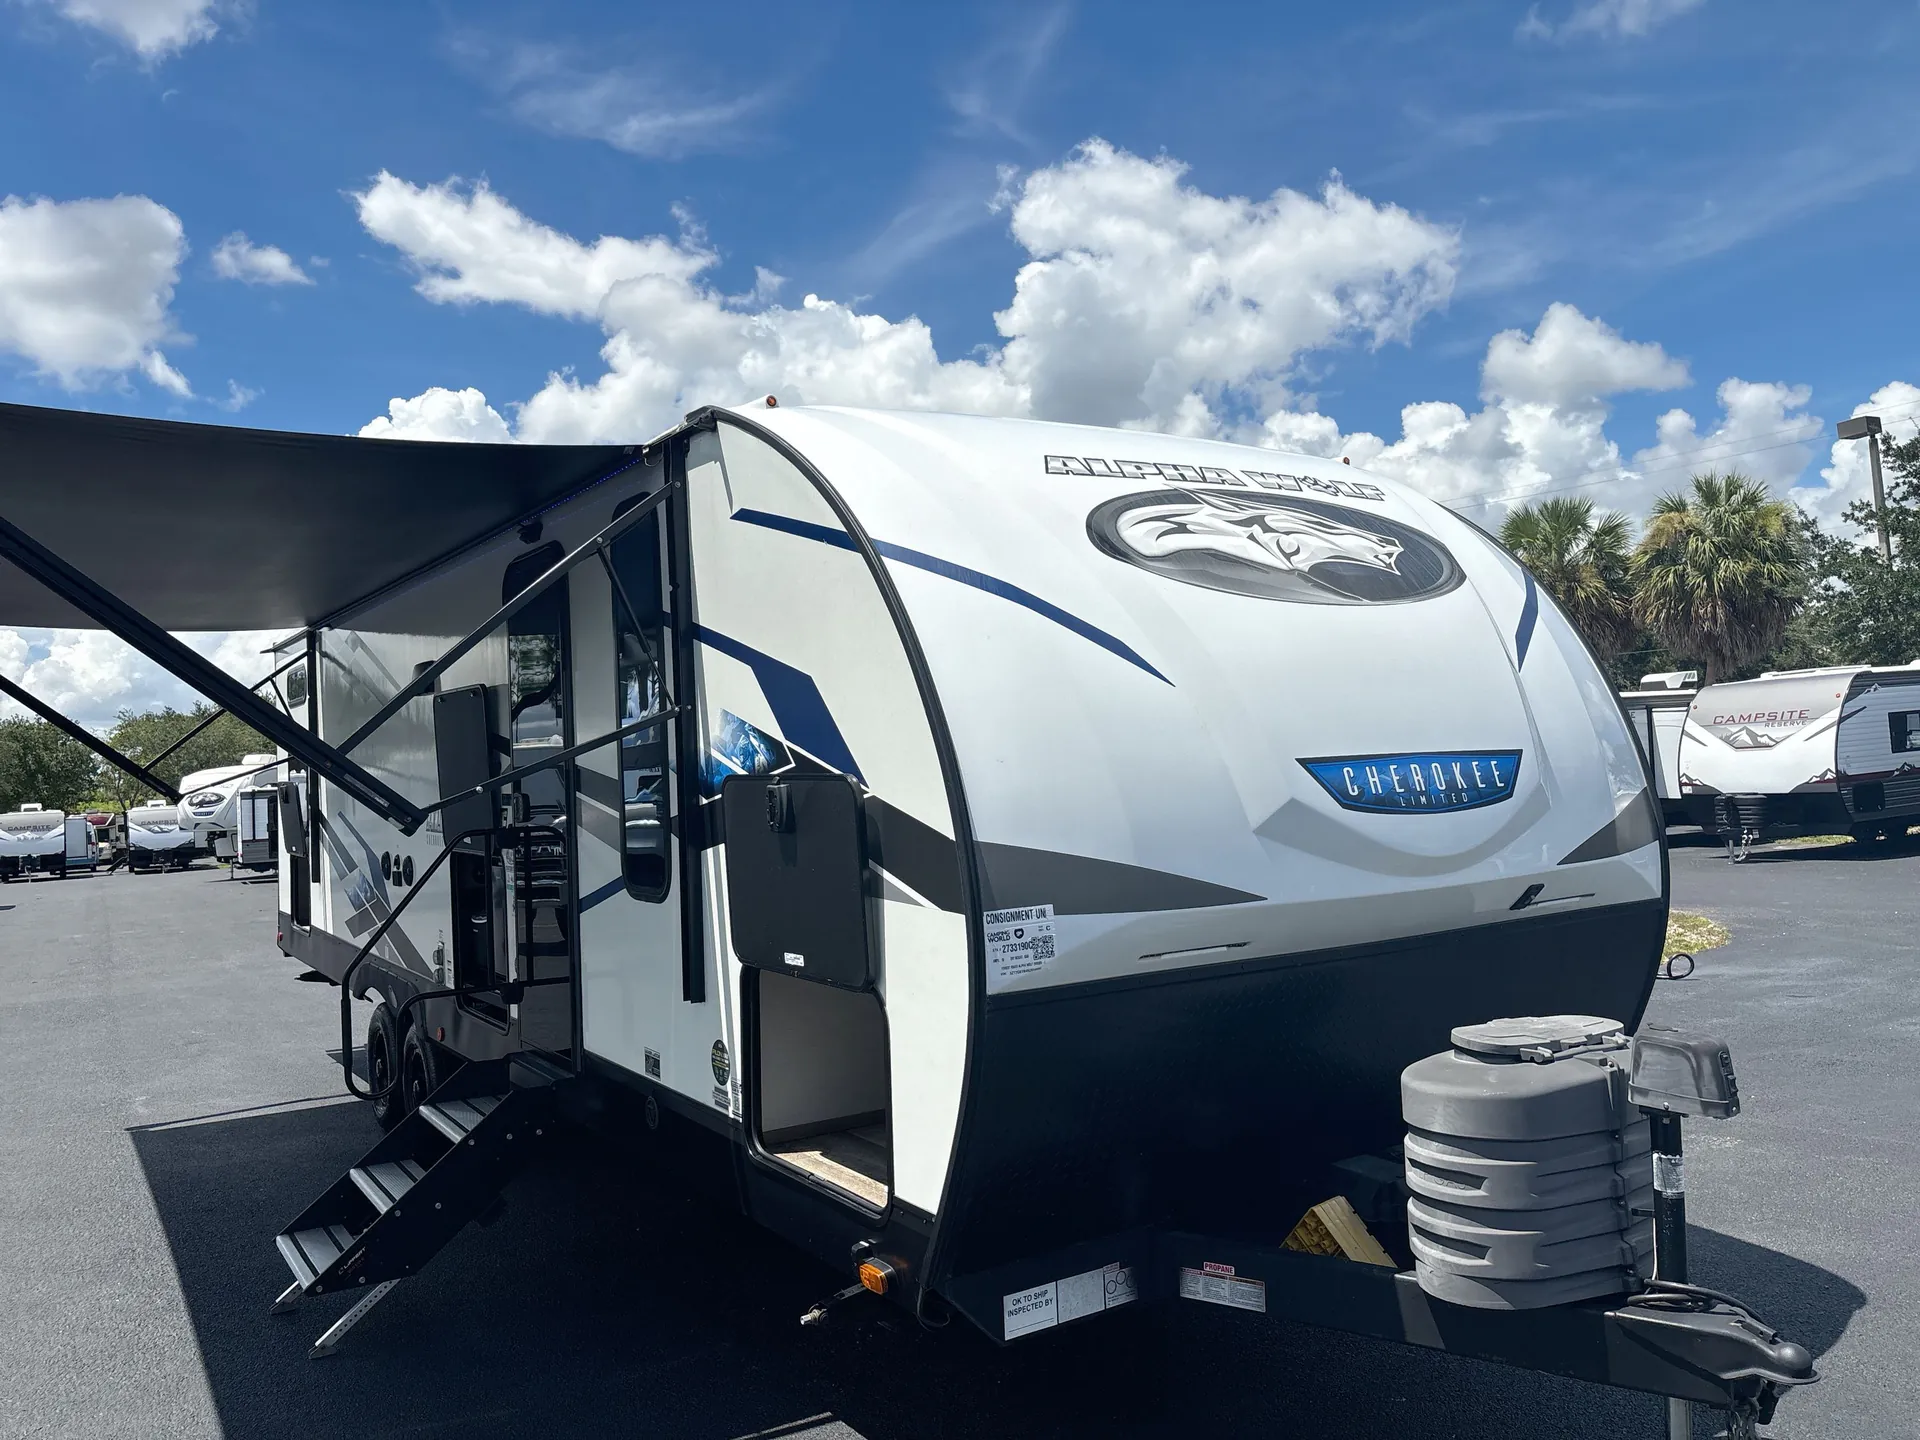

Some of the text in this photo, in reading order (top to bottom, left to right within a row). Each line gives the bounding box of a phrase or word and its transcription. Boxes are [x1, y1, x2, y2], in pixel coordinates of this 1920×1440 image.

[1044, 455, 1248, 487] ALPHA
[1713, 709, 1810, 725] CAMPSITE
[1764, 719, 1807, 729] RESERVE
[1342, 760, 1505, 796] CHEROKEE
[1400, 792, 1468, 807] LIMITED
[986, 909, 1034, 925] CONSIGNMENT
[987, 935, 1011, 943] WORLD
[1204, 1262, 1234, 1274] PROPANE
[1012, 1289, 1048, 1306] OK TO SHIP
[1007, 1297, 1054, 1317] INSPECTED BY
